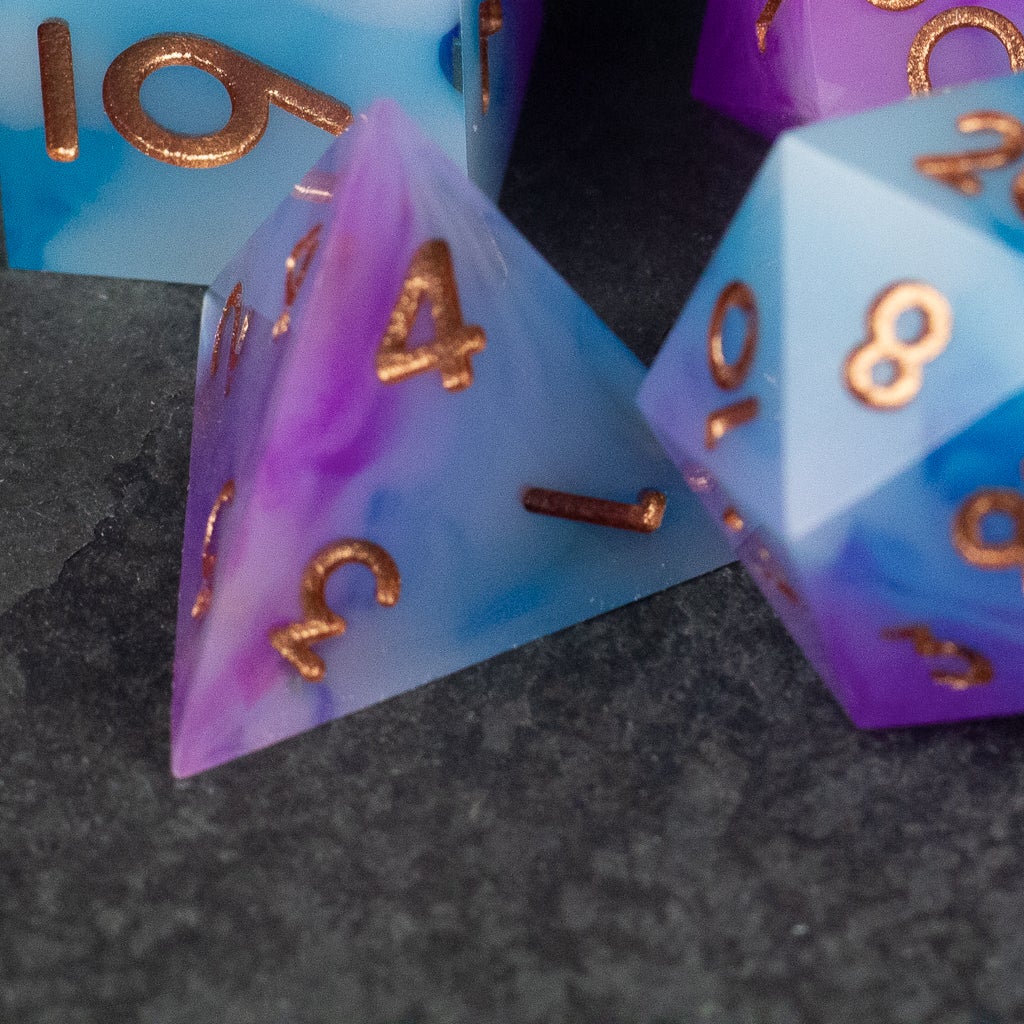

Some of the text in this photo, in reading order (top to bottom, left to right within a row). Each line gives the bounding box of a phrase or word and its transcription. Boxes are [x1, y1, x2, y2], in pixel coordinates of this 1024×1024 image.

[376, 238, 488, 393] 4
[843, 281, 953, 410] 8
[521, 487, 666, 533] 1
[268, 538, 400, 681] 3
